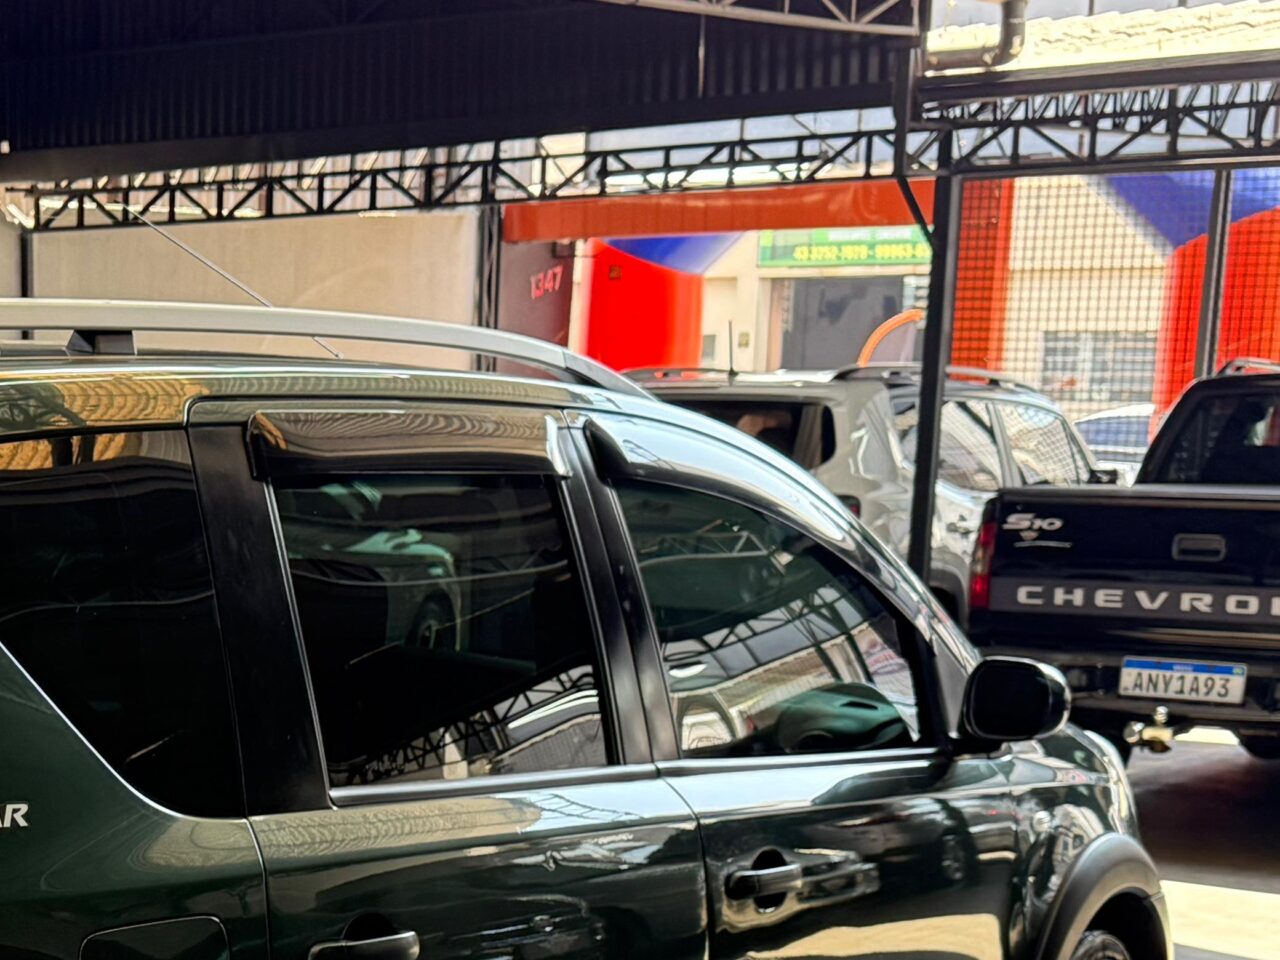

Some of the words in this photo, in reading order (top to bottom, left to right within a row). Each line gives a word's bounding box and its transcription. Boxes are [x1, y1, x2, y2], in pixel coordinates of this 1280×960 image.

[530, 265, 564, 300] 1347
[1002, 512, 1052, 531] S10
[1132, 671, 1231, 698] ANY1A93
